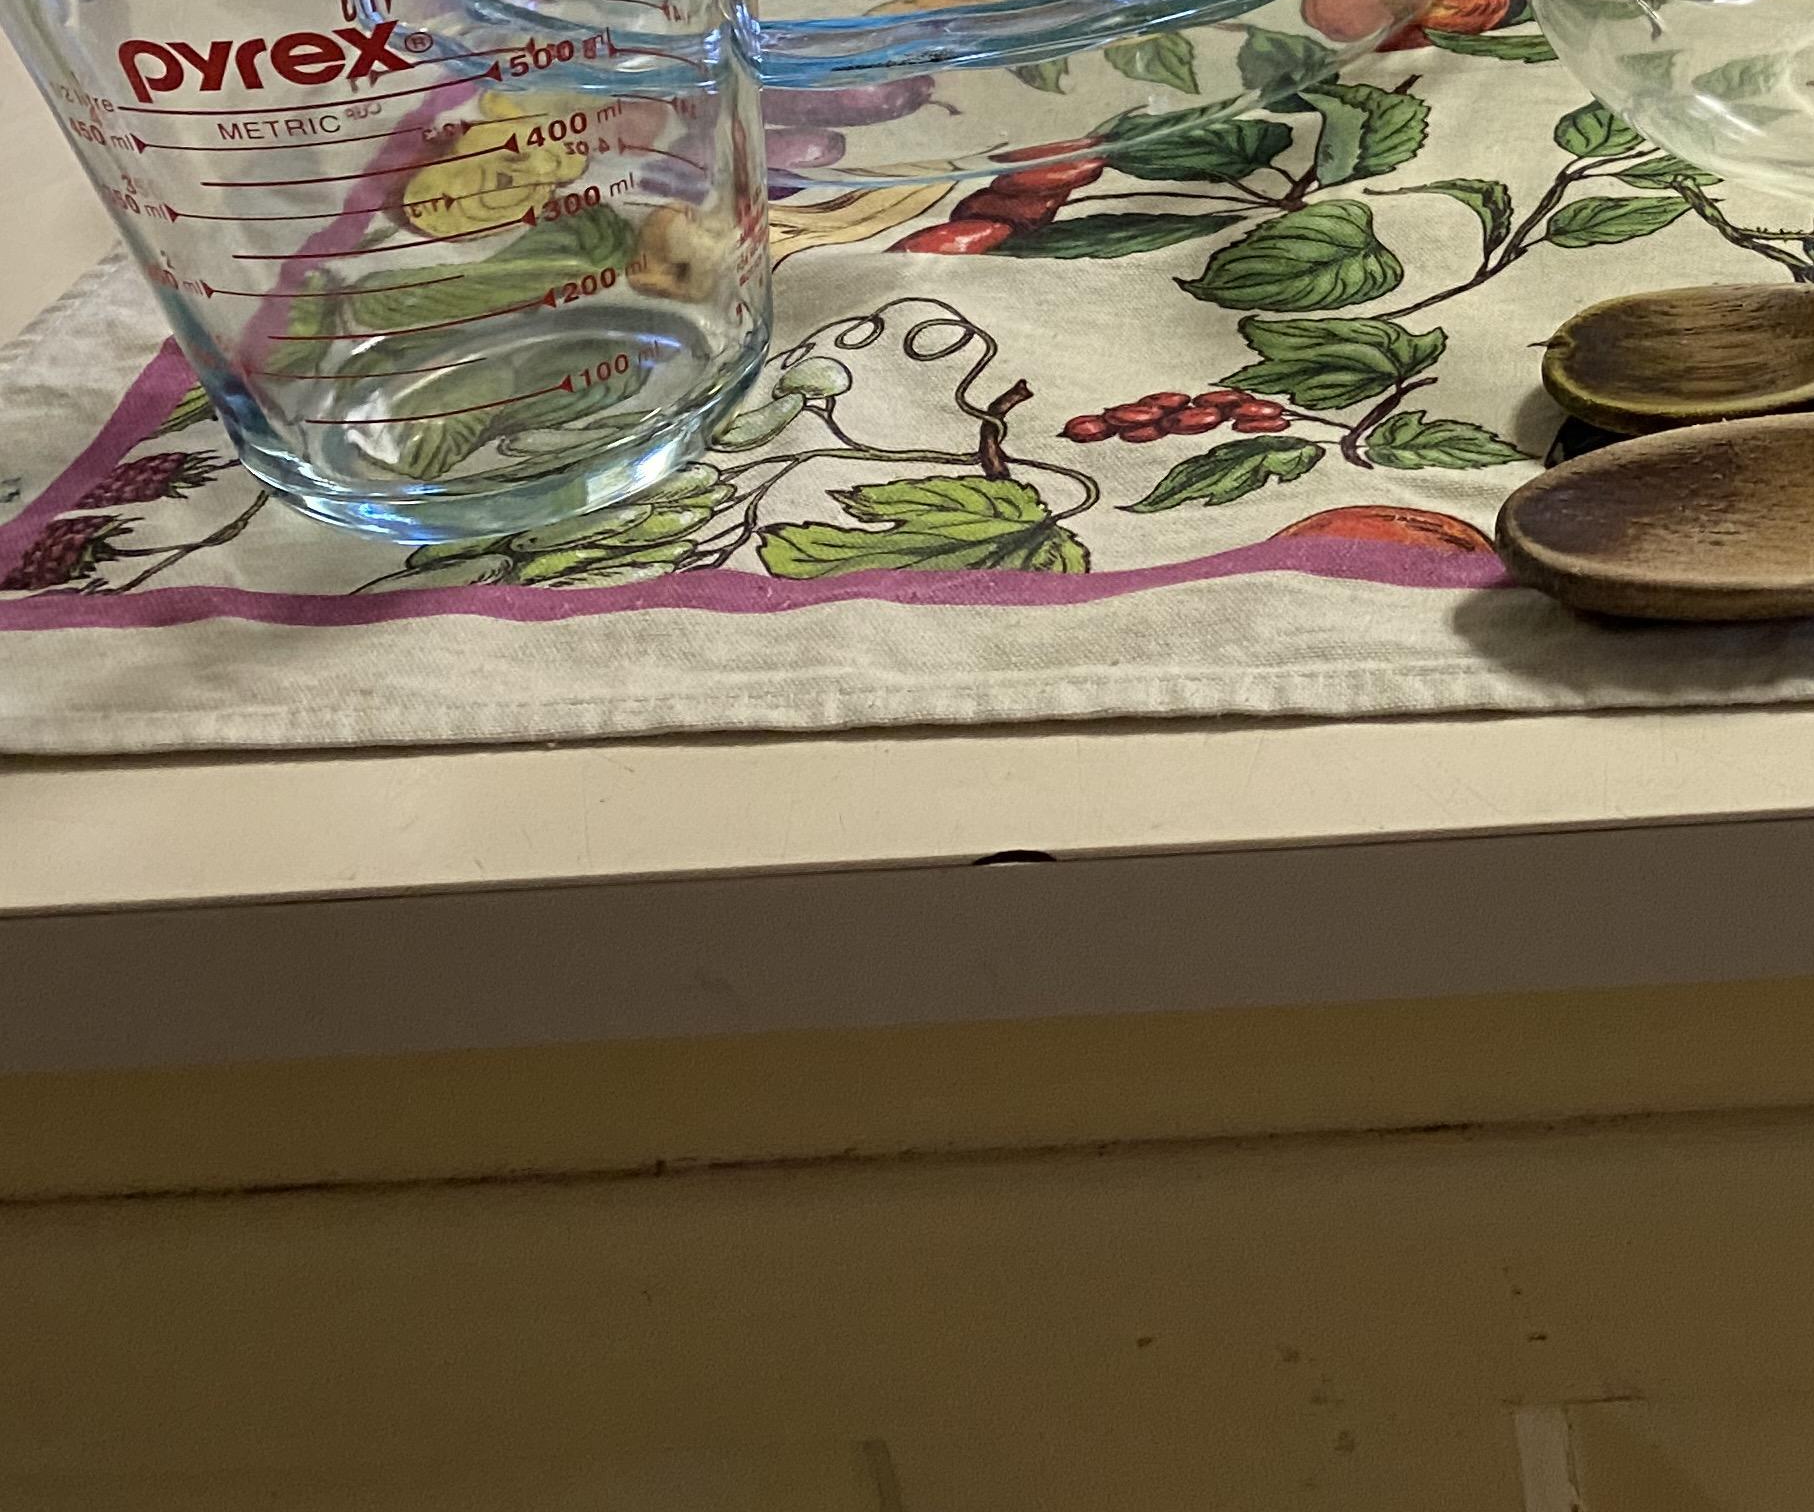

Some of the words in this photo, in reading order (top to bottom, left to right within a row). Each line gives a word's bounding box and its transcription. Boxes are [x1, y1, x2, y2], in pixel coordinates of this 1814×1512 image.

[118, 19, 415, 104] pyrex
[510, 40, 574, 77] 500
[218, 115, 342, 141] METRIC
[527, 112, 588, 148] 400
[597, 99, 623, 123] ml
[542, 185, 601, 222] 300
[610, 172, 635, 197] ml
[563, 267, 616, 303] 200
[625, 253, 648, 277] ml
[580, 353, 629, 387] 100
